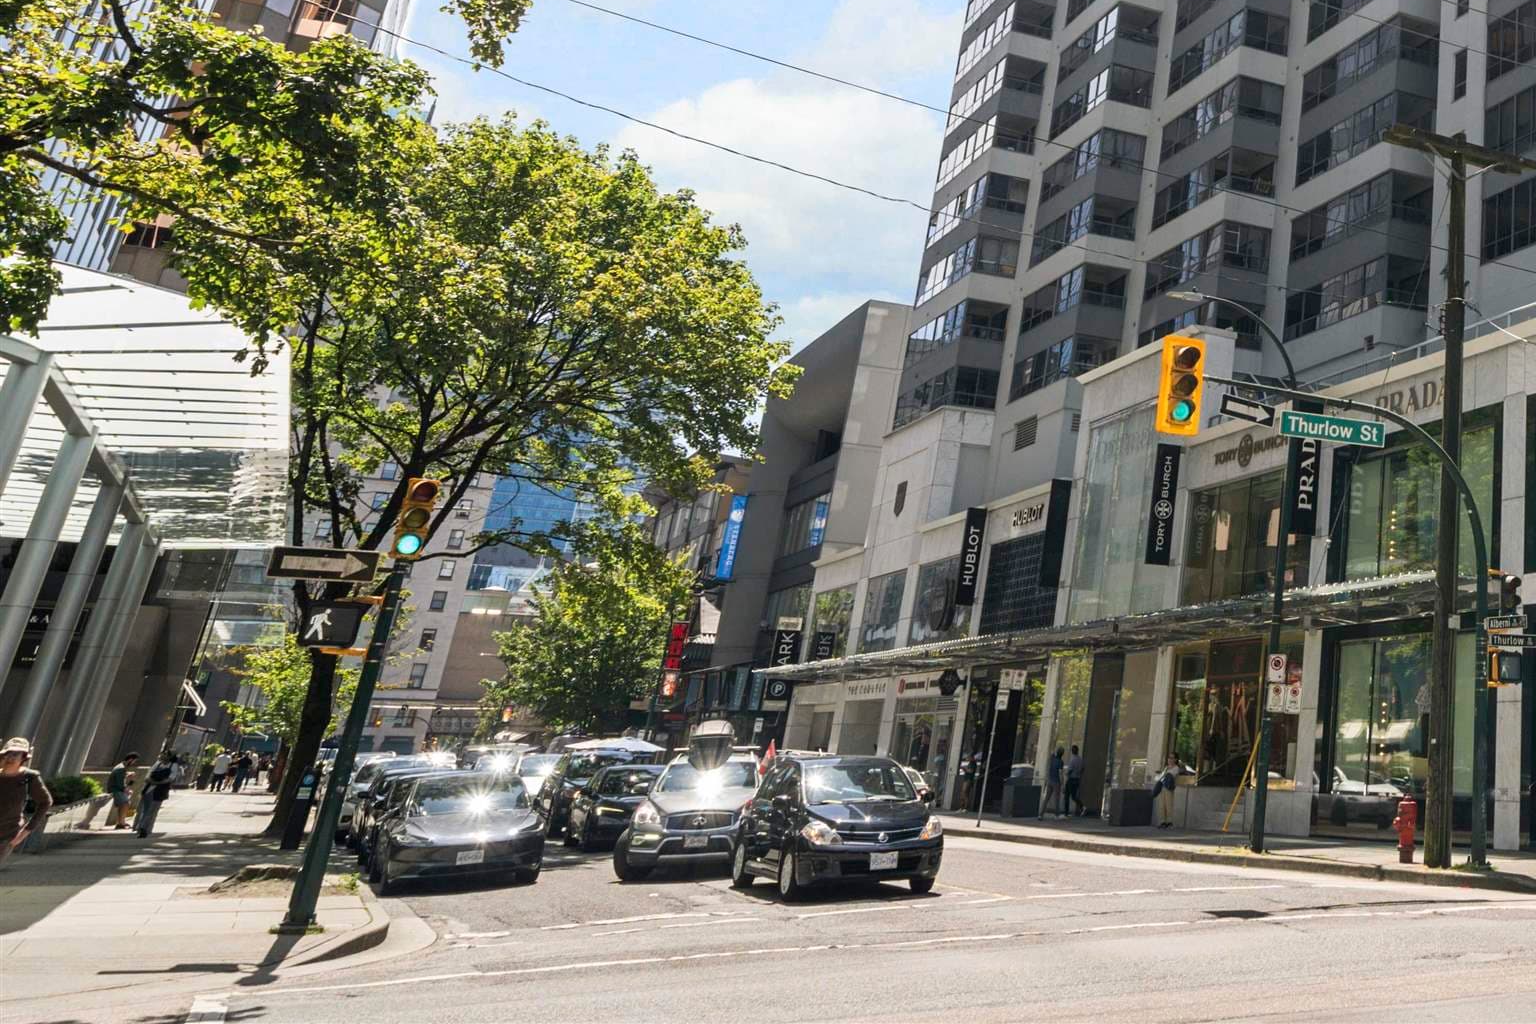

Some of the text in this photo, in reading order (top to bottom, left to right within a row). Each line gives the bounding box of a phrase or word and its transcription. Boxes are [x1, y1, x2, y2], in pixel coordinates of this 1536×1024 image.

[1287, 416, 1378, 442] Thurlow St
[1214, 436, 1288, 466] TORY BURCH
[1298, 438, 1317, 511] PRAD
[1012, 504, 1044, 527] HUBLOT
[1155, 456, 1173, 553] TORY BURCH
[962, 526, 981, 586] HUBLOT
[1490, 618, 1511, 628] Alberni
[1494, 635, 1524, 645] Thurlow
